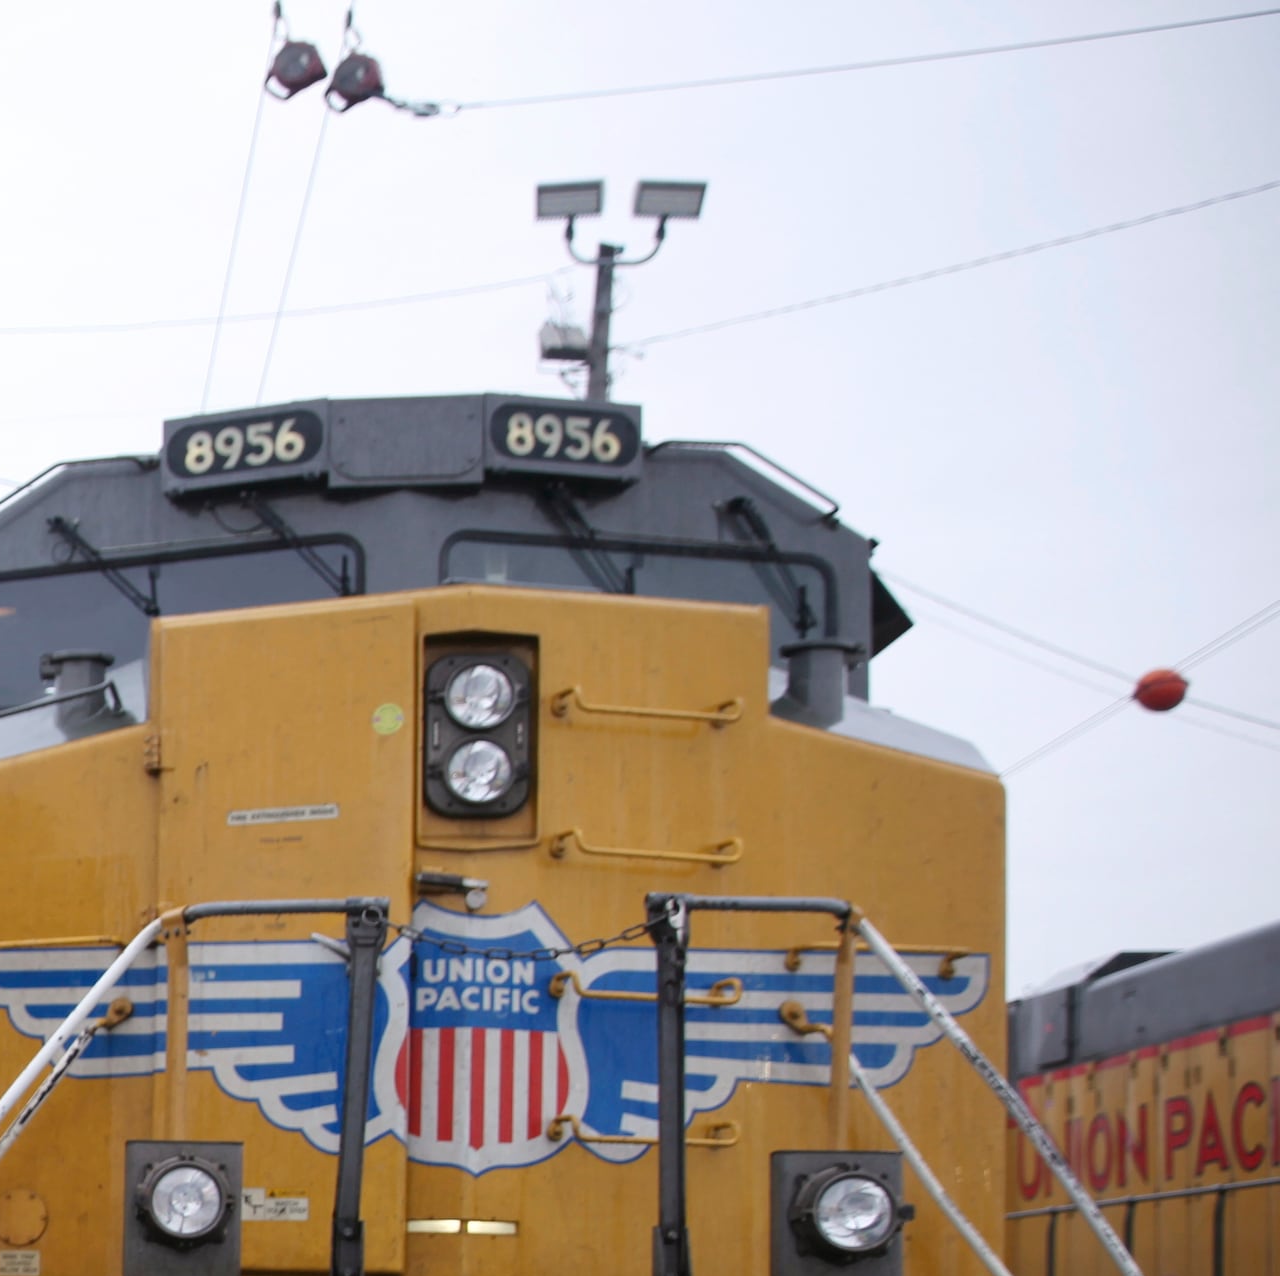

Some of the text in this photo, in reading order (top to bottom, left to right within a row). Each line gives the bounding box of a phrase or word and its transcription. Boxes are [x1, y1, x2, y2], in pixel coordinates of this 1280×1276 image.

[184, 417, 306, 475] 8956
[505, 412, 621, 463] 8956
[423, 957, 535, 985] UNION
[415, 986, 540, 1014] PACIFIC
